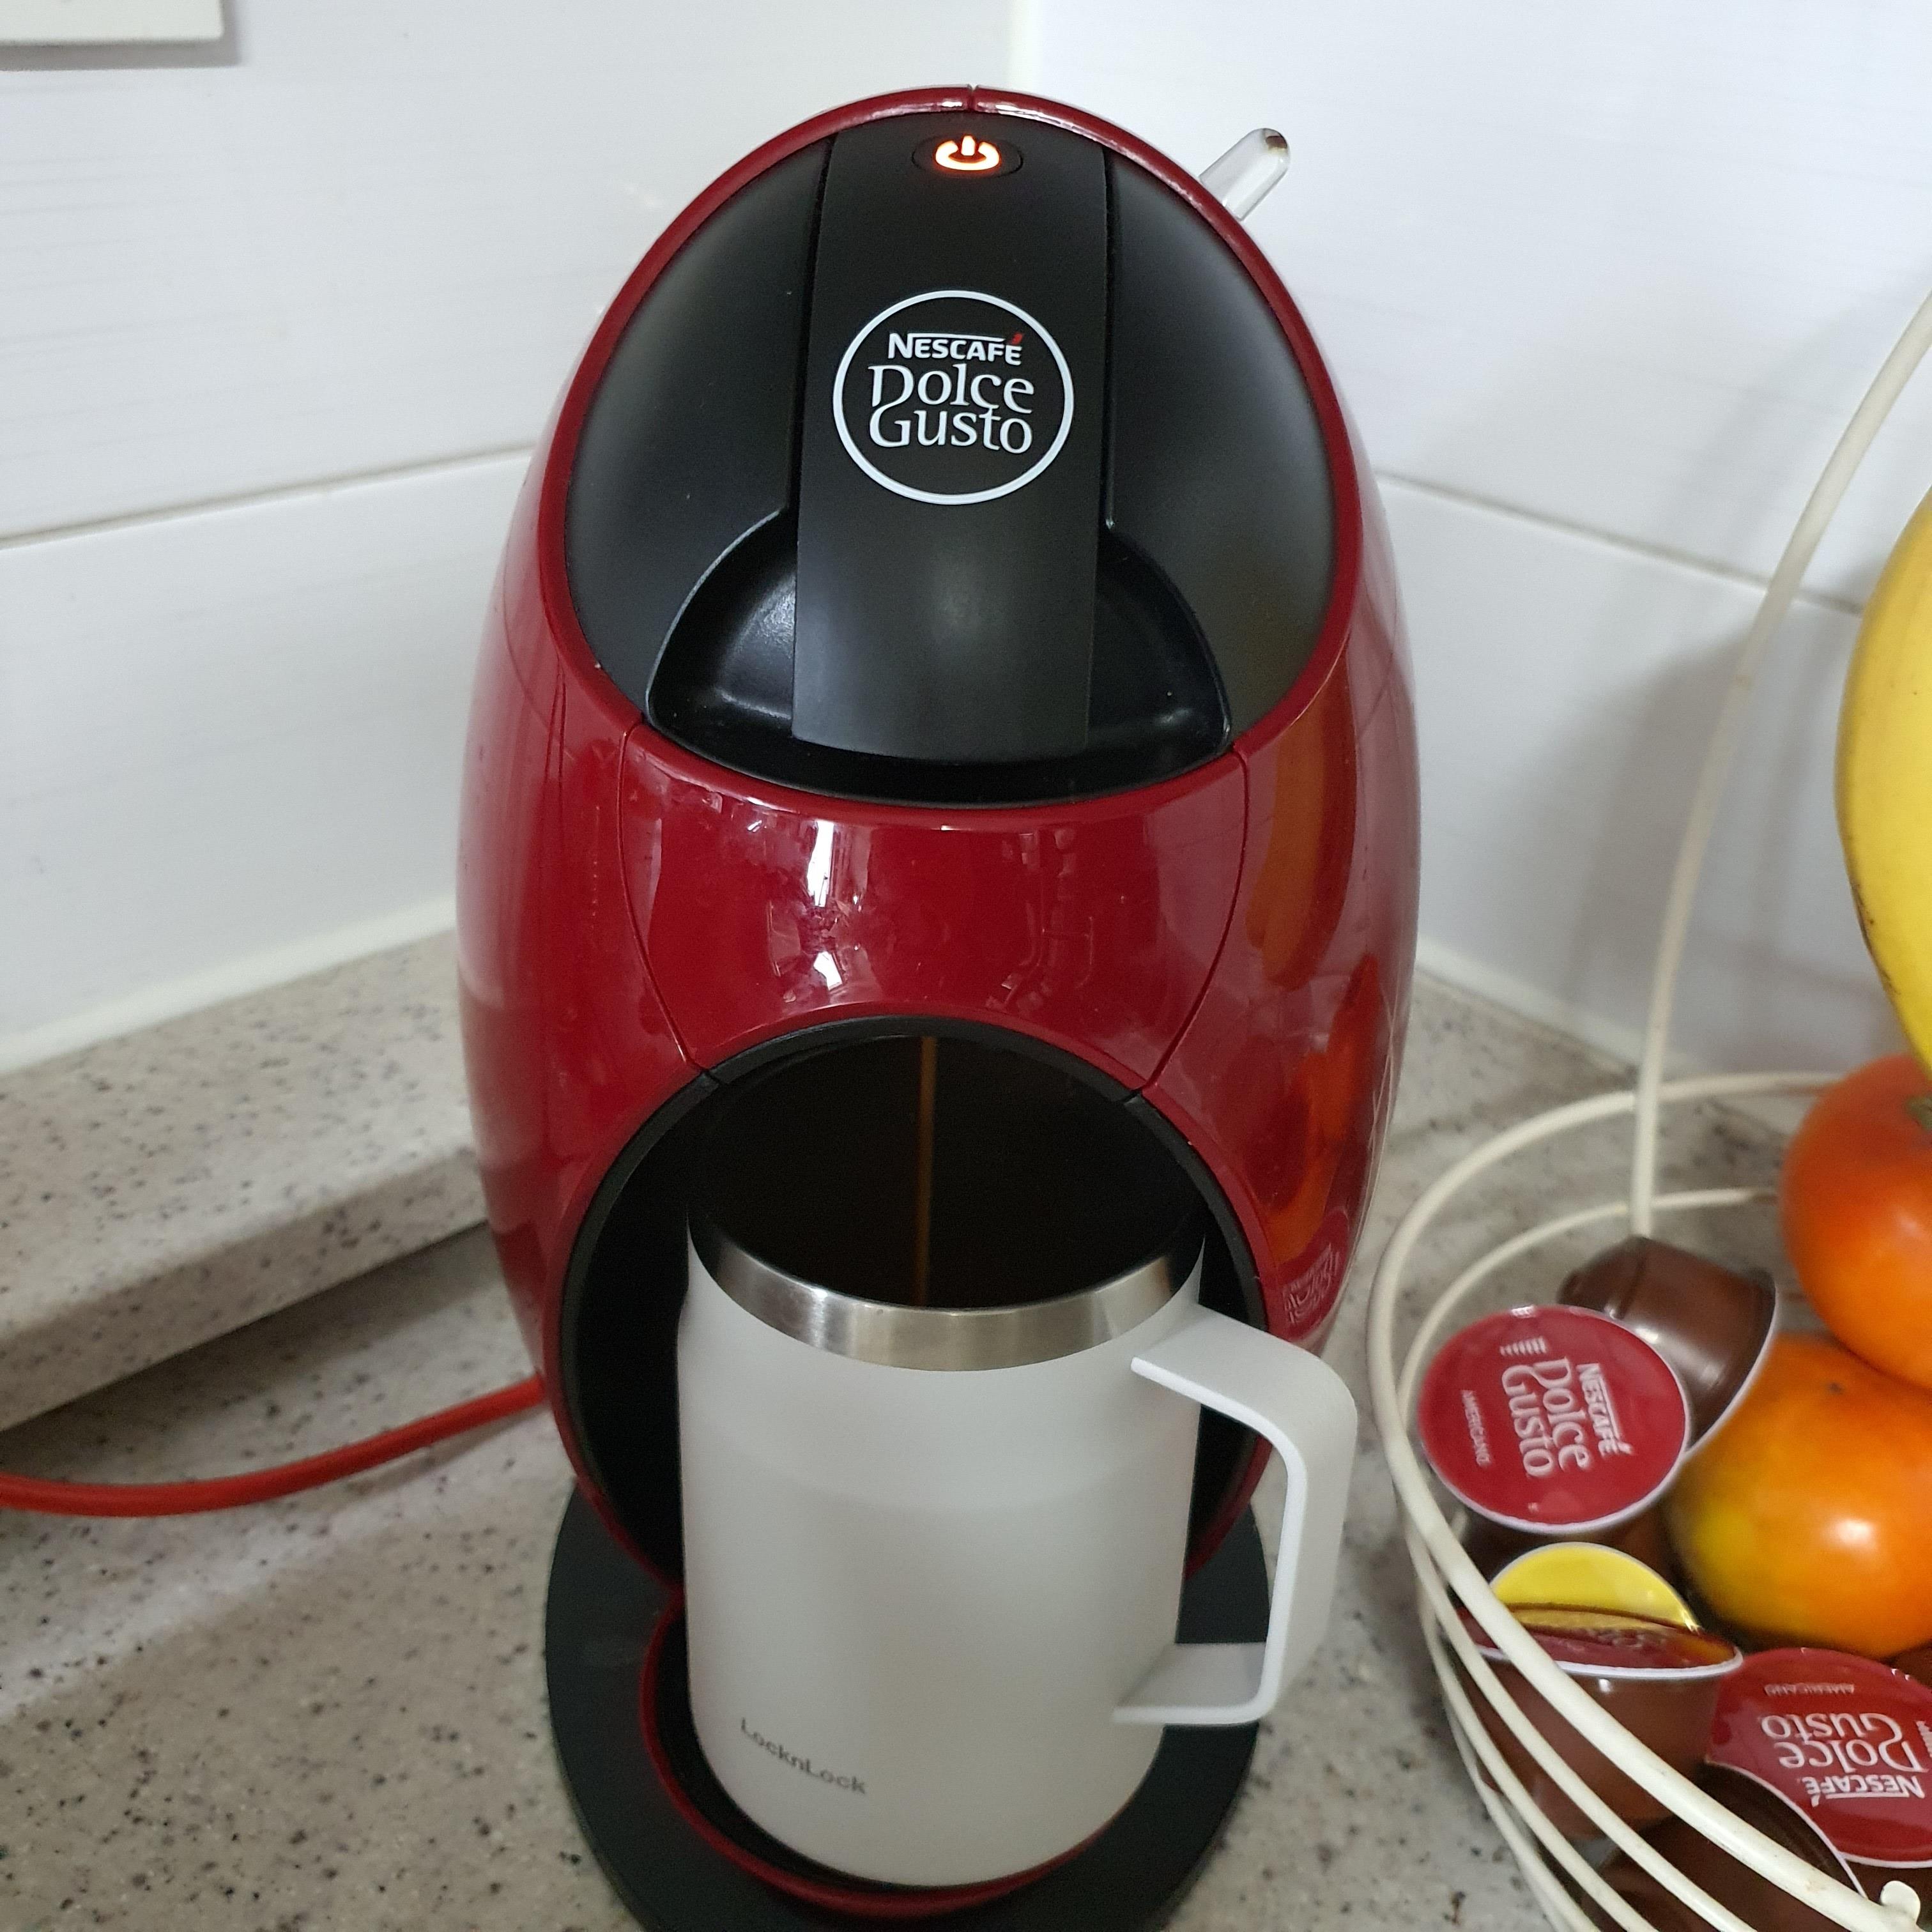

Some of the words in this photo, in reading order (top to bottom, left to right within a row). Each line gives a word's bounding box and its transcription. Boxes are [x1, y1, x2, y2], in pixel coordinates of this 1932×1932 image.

[888, 333, 1024, 365] NESCAFÉ
[868, 364, 1034, 414] Dolce
[869, 406, 1032, 454] Gusto
[1501, 1364, 1554, 1478] Gusto
[1533, 1357, 1593, 1471] Dolce
[1576, 1363, 1634, 1457] NESCAFÉ
[1761, 1712, 1903, 1744] Gusto
[1774, 1739, 1929, 1774] Dolce
[1802, 1774, 1926, 1807] NESCAFÉ
